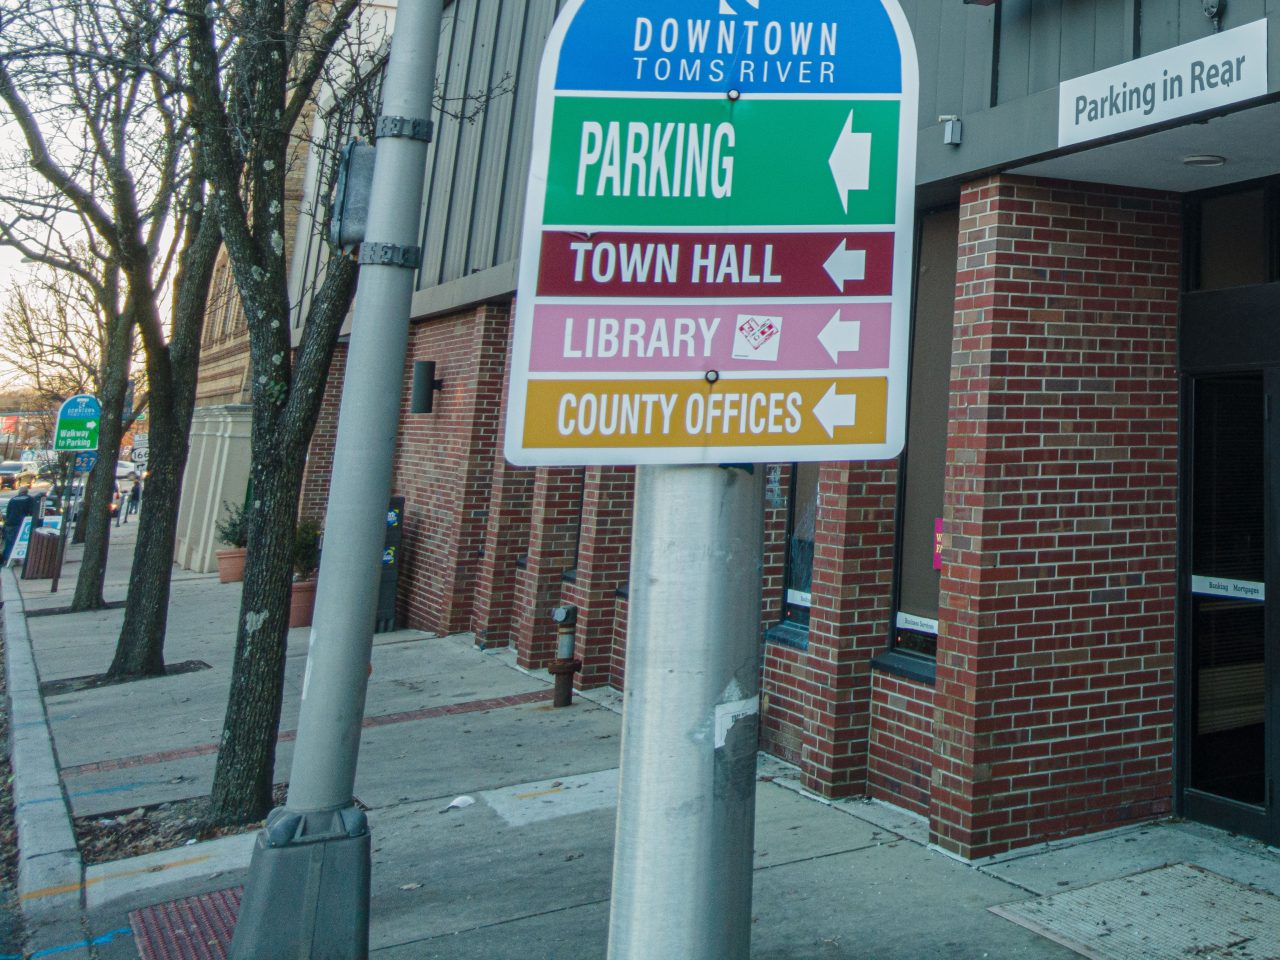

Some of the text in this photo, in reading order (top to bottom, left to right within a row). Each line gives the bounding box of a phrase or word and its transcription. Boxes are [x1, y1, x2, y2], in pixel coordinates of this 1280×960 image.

[633, 17, 837, 57] DOWNTOWN
[633, 57, 835, 84] TOMS RIVER
[1074, 55, 1246, 126] Parking in Rear
[576, 121, 736, 200] PARKING
[570, 242, 782, 284] TOWN HALL
[563, 317, 721, 358] LIBRARY
[60, 429, 90, 438] Walkway
[558, 391, 802, 436] COUNTY OFFICES
[66, 439, 91, 448] Parking
[76, 457, 95, 467] 527
